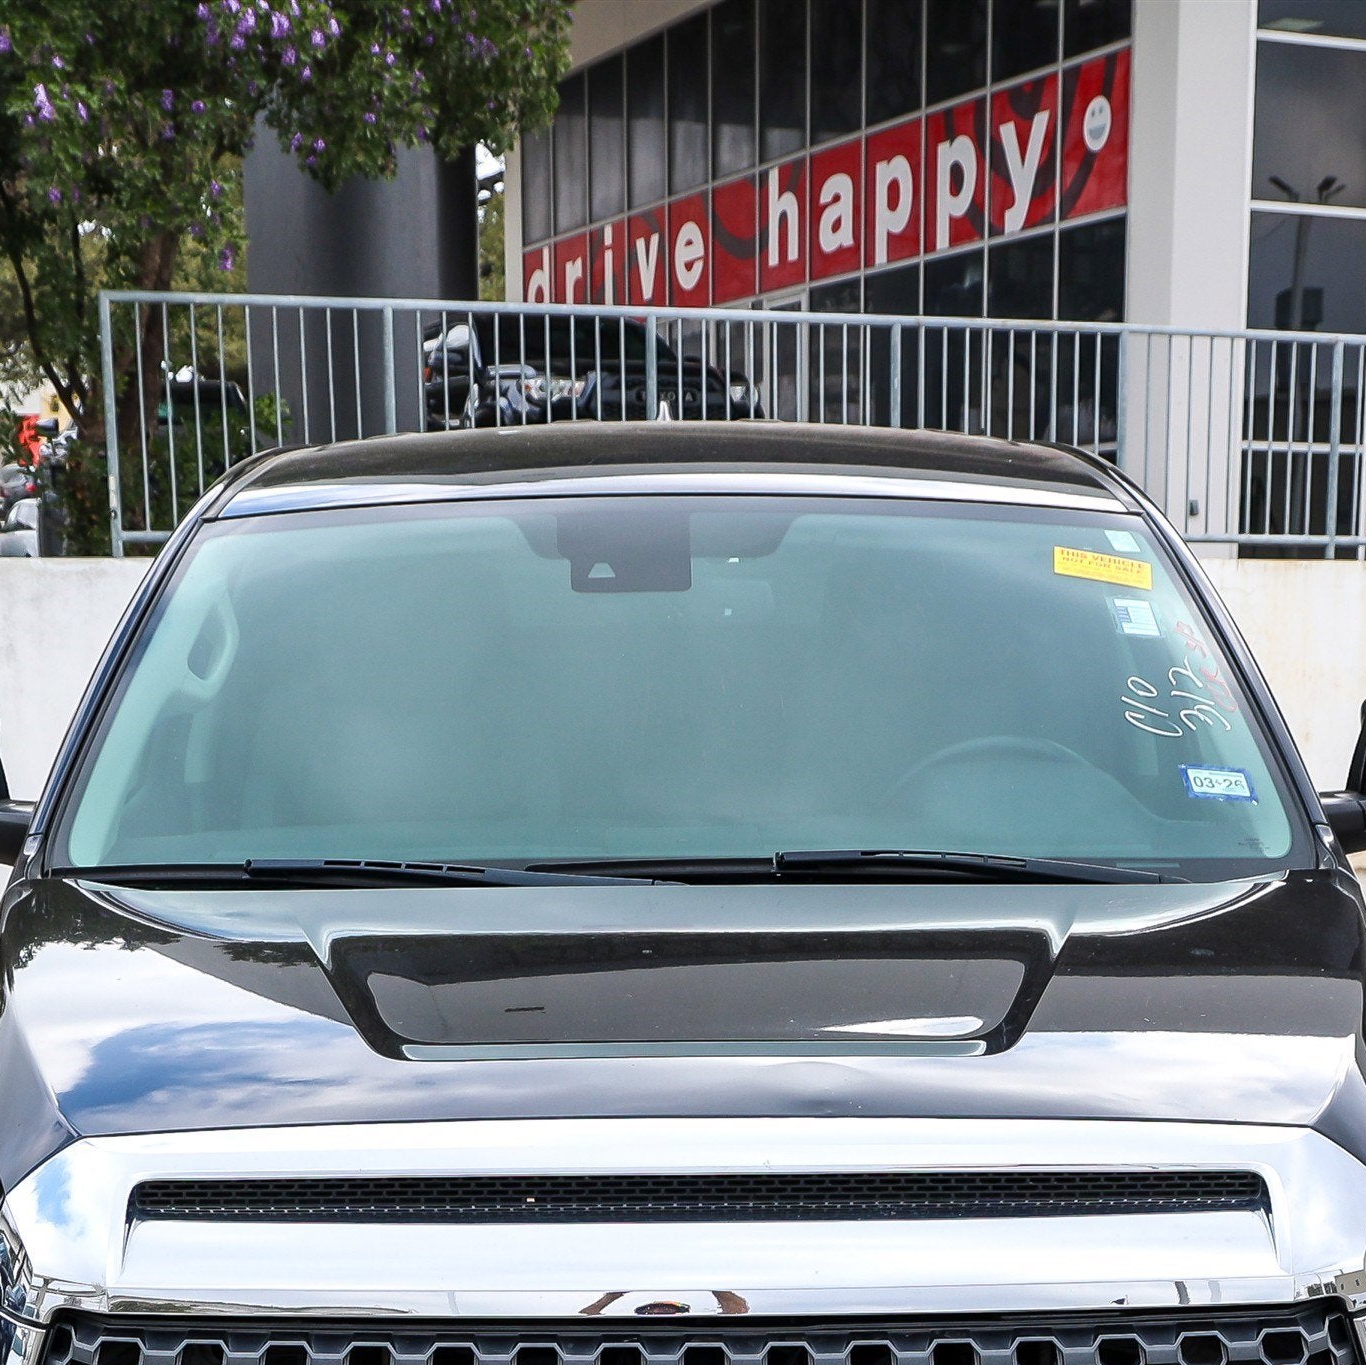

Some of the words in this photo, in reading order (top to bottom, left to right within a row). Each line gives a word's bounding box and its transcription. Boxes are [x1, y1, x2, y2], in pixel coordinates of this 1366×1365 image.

[527, 218, 705, 305] drive
[767, 108, 1050, 268] happy
[1060, 548, 1087, 560] THIS
[1092, 554, 1145, 570] VEHICLE
